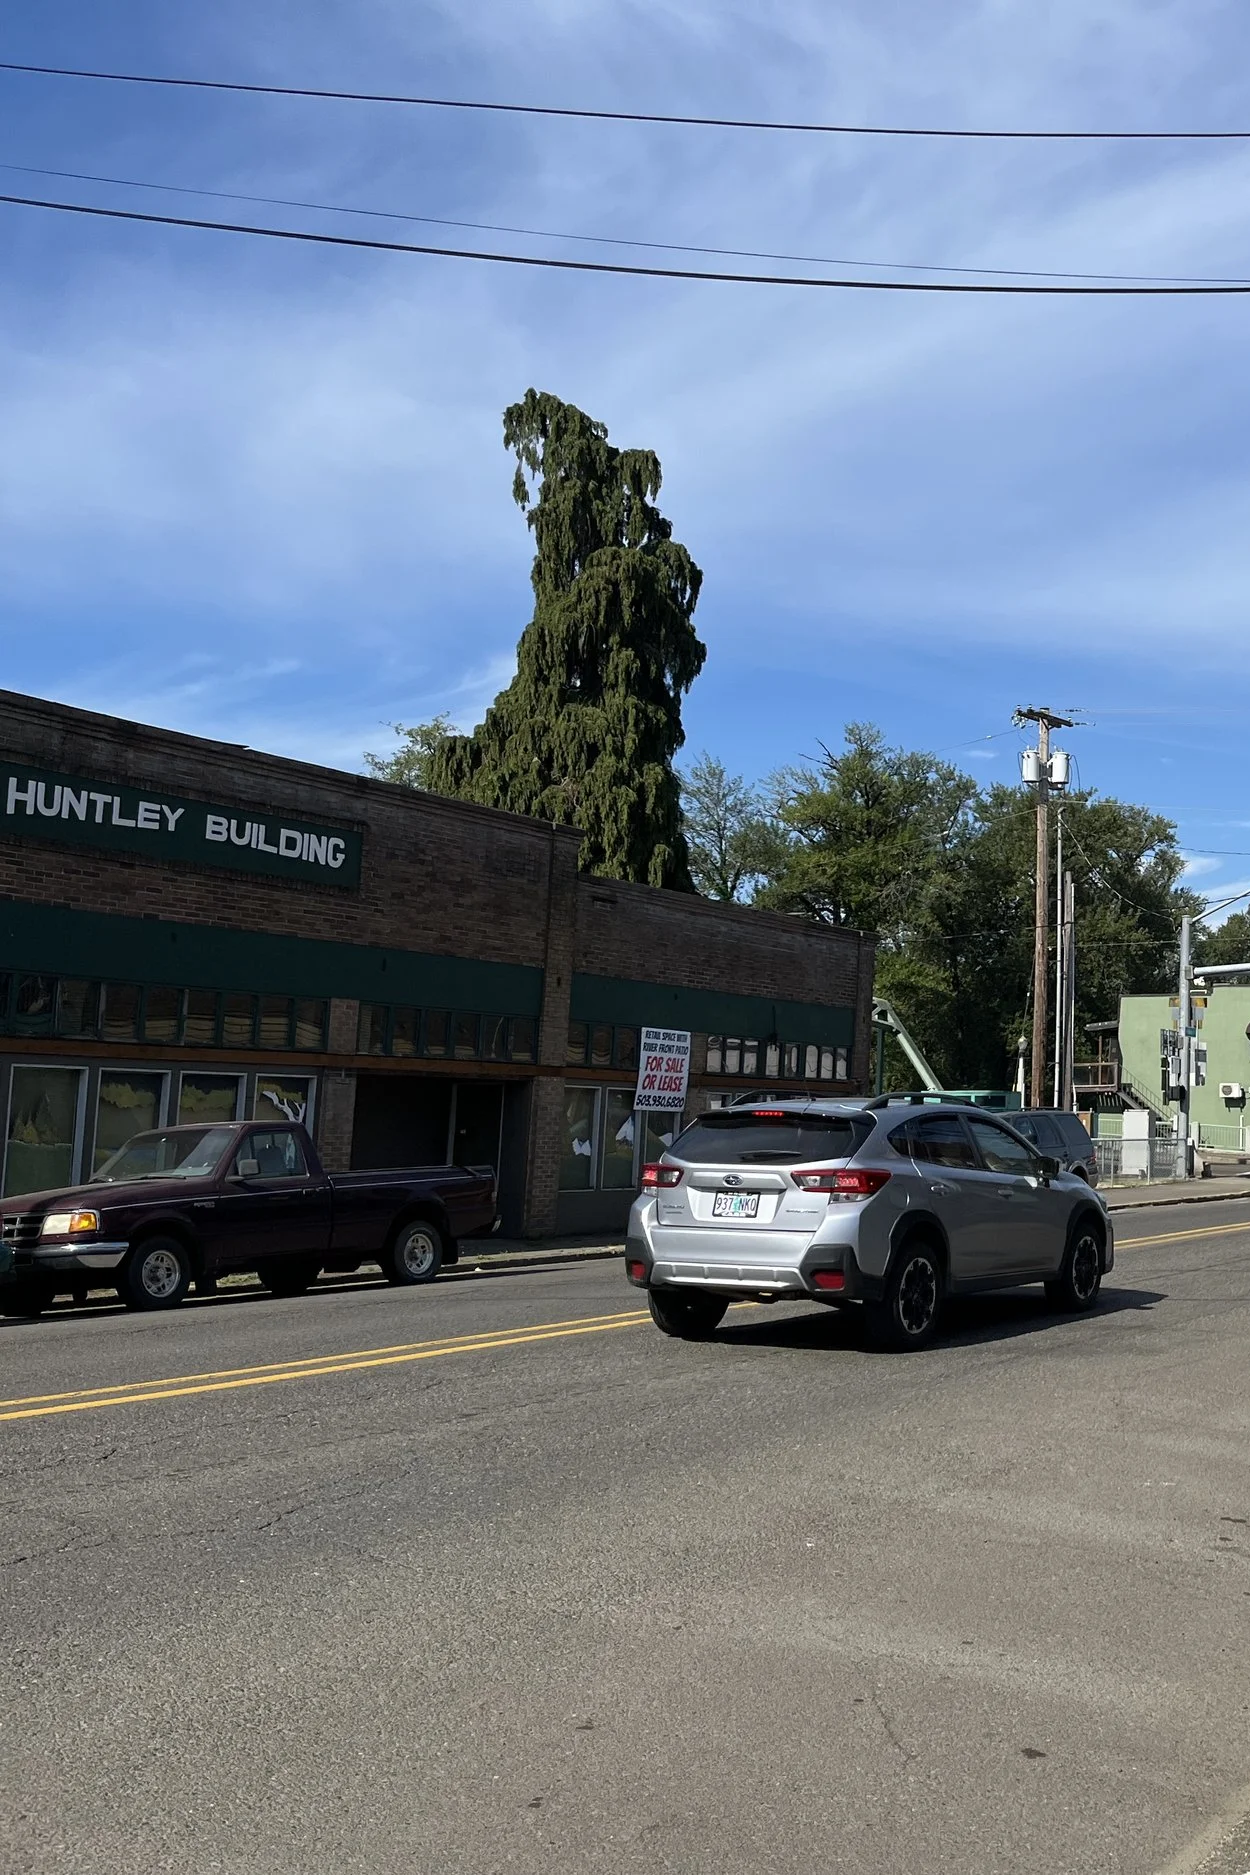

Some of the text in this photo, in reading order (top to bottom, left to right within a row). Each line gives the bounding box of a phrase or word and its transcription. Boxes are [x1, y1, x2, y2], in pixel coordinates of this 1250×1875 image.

[6, 776, 346, 869] HUNTLEY BUILDING
[645, 1030, 661, 1040] RETAIL
[662, 1032, 676, 1041] SPACE
[643, 1042, 689, 1055] RIVER FRONT PATIO
[645, 1055, 685, 1073] FOR SALE
[642, 1073, 684, 1092] OR LEASE
[636, 1094, 685, 1108] 503.930.6820
[716, 1197, 734, 1211] 937
